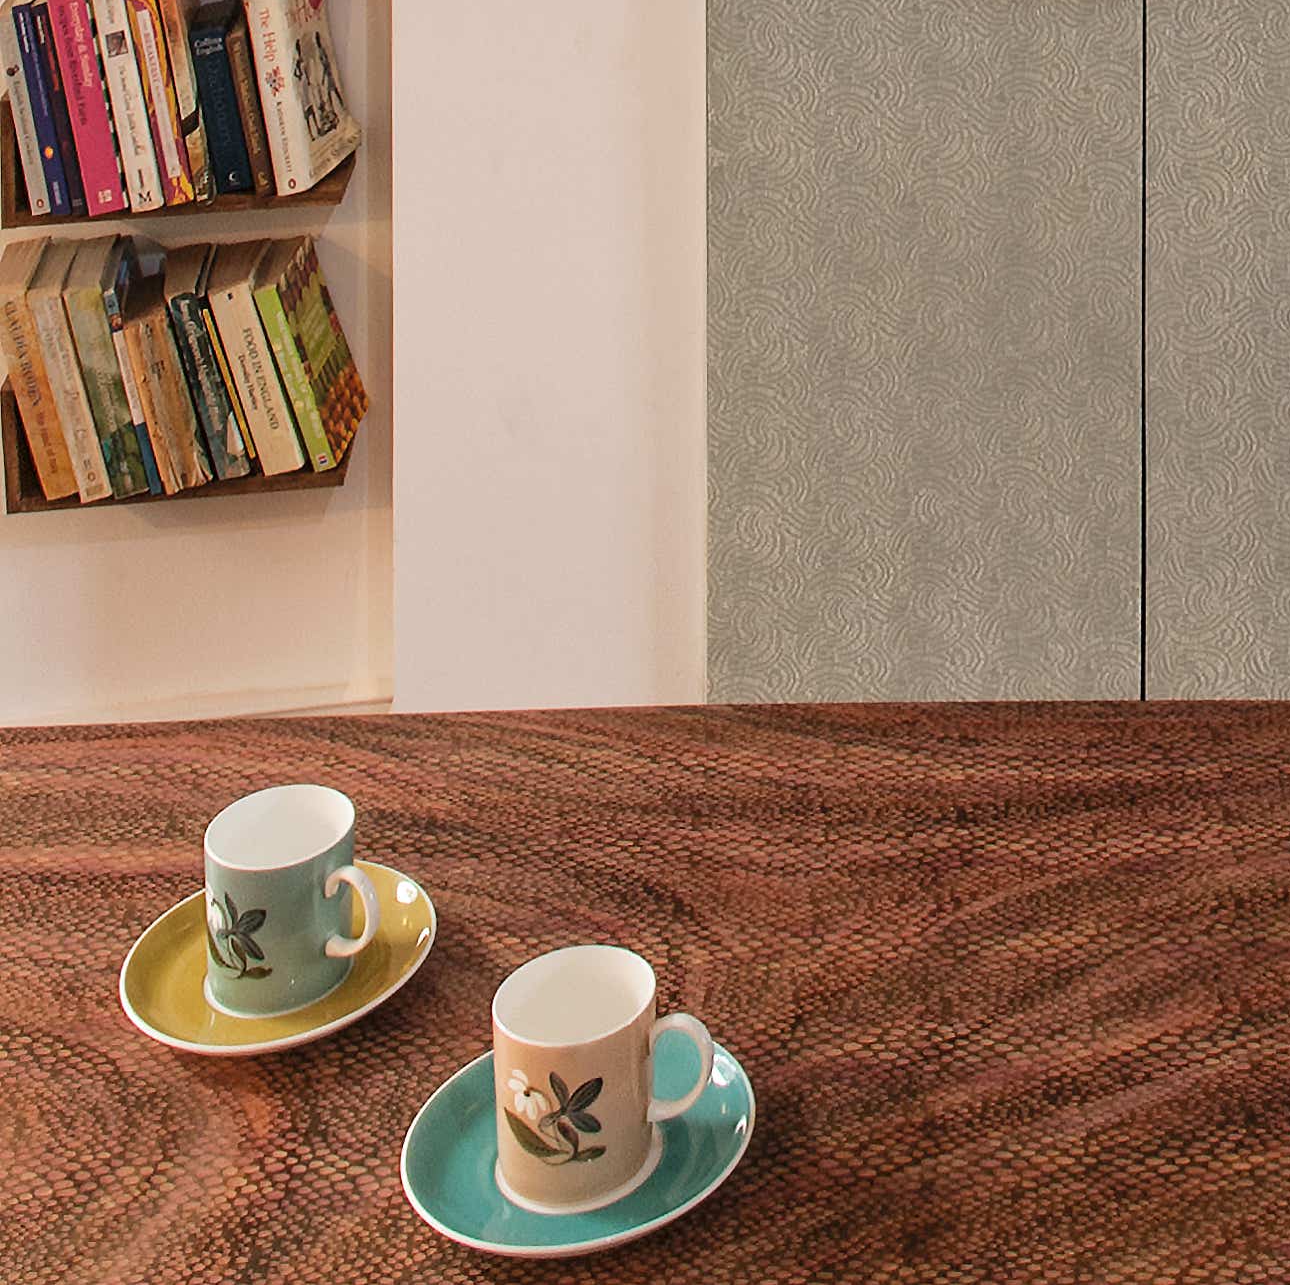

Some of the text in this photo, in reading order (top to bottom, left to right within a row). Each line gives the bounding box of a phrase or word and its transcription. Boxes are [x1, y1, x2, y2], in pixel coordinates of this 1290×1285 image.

[56, 6, 69, 38] recipes
[64, 39, 75, 58] from
[67, 2, 94, 87] Everyday & Sunday
[194, 37, 222, 48] Collins
[196, 45, 223, 56] English
[258, 9, 278, 62] The Help
[4, 300, 42, 406] CLAUDIA RODEN
[242, 327, 280, 430] FOOD IN ENGLAND
